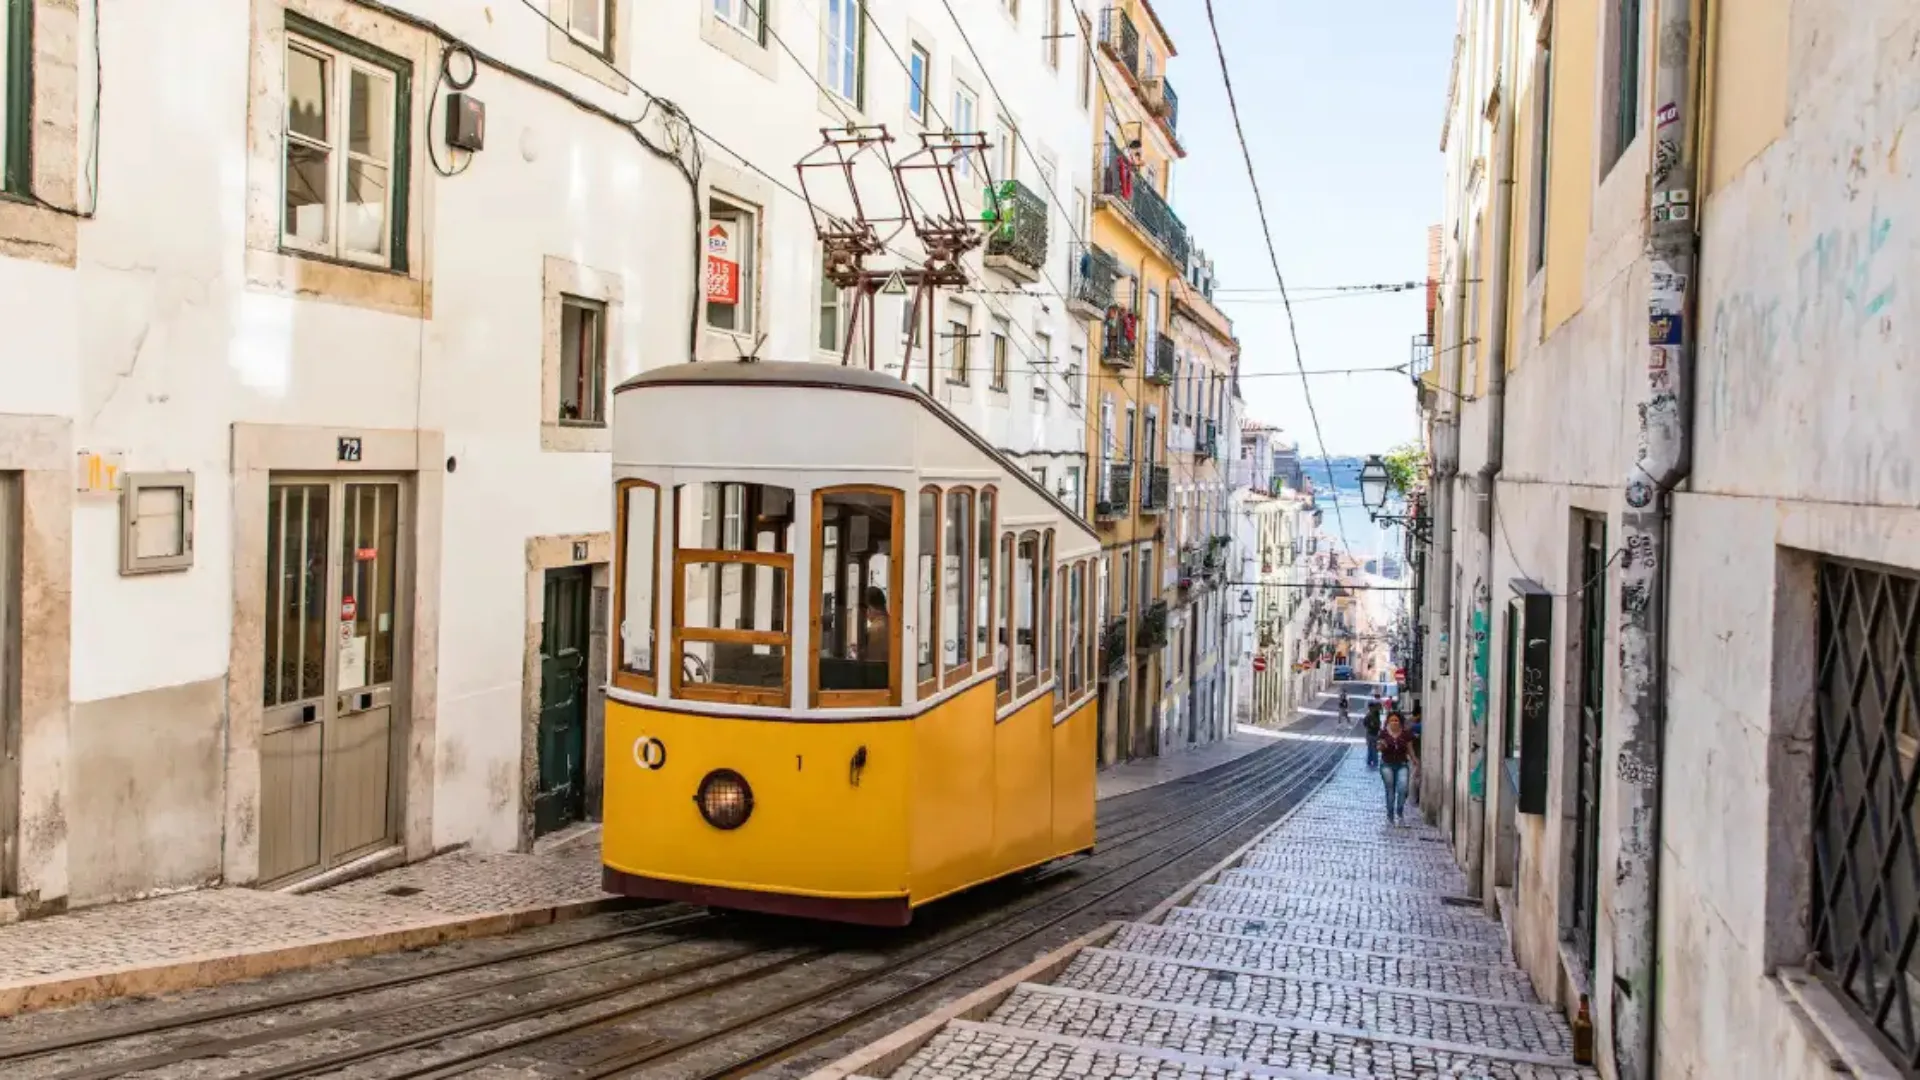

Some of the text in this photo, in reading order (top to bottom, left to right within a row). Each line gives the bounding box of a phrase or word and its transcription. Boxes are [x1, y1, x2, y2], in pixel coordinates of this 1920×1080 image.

[709, 237, 728, 247] ERA
[342, 439, 359, 460] 72
[796, 754, 803, 772] 1
